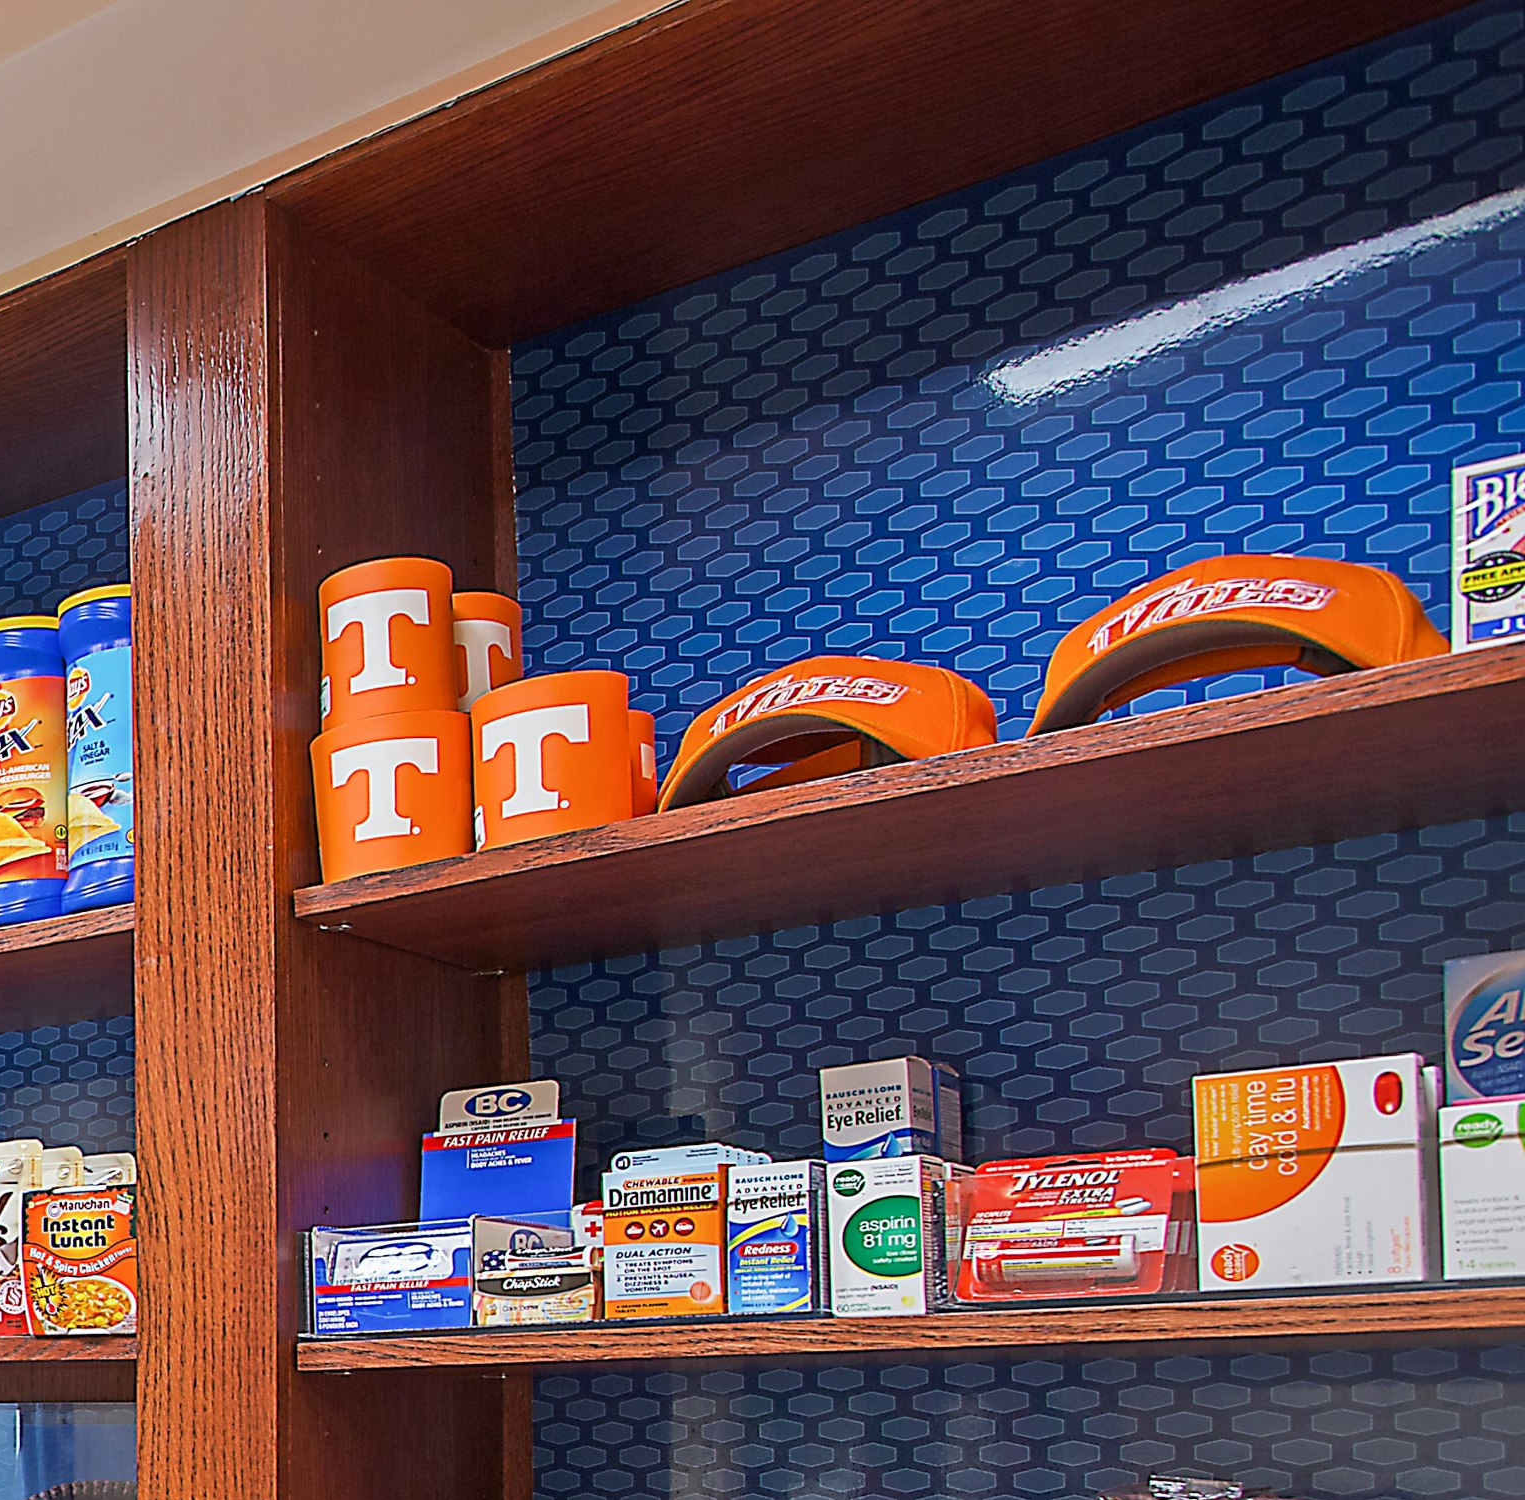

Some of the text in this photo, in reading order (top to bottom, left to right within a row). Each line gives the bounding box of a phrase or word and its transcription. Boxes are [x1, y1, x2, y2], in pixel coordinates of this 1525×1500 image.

[328, 589, 429, 694] T
[482, 704, 589, 818] T
[331, 738, 438, 842] T
[475, 1092, 524, 1113] BC
[1245, 1079, 1267, 1126] time
[827, 1105, 902, 1131] Eye Relief
[1272, 1078, 1297, 1175] cold flu
[443, 1128, 550, 1148] FAST PAIN RELIEF
[626, 1177, 680, 1189] CHEWABLE
[1012, 1171, 1121, 1193] TYLENOL
[609, 1186, 712, 1208] Dramamine
[1060, 1187, 1115, 1199] EXTRA
[58, 1199, 109, 1210] Maruchan
[734, 1194, 804, 1212] Eye Relief
[43, 1214, 115, 1232] Instant
[859, 1217, 916, 1235] aspirin
[51, 1231, 106, 1248] Lunch
[863, 1235, 916, 1249] 81 mg
[616, 1247, 691, 1259] DUAL ACTION
[744, 1244, 791, 1255] Redness
[54, 1255, 115, 1274] Spicy Chicken
[36, 1286, 57, 1298] HOT
[502, 1277, 561, 1290] ChapStick
